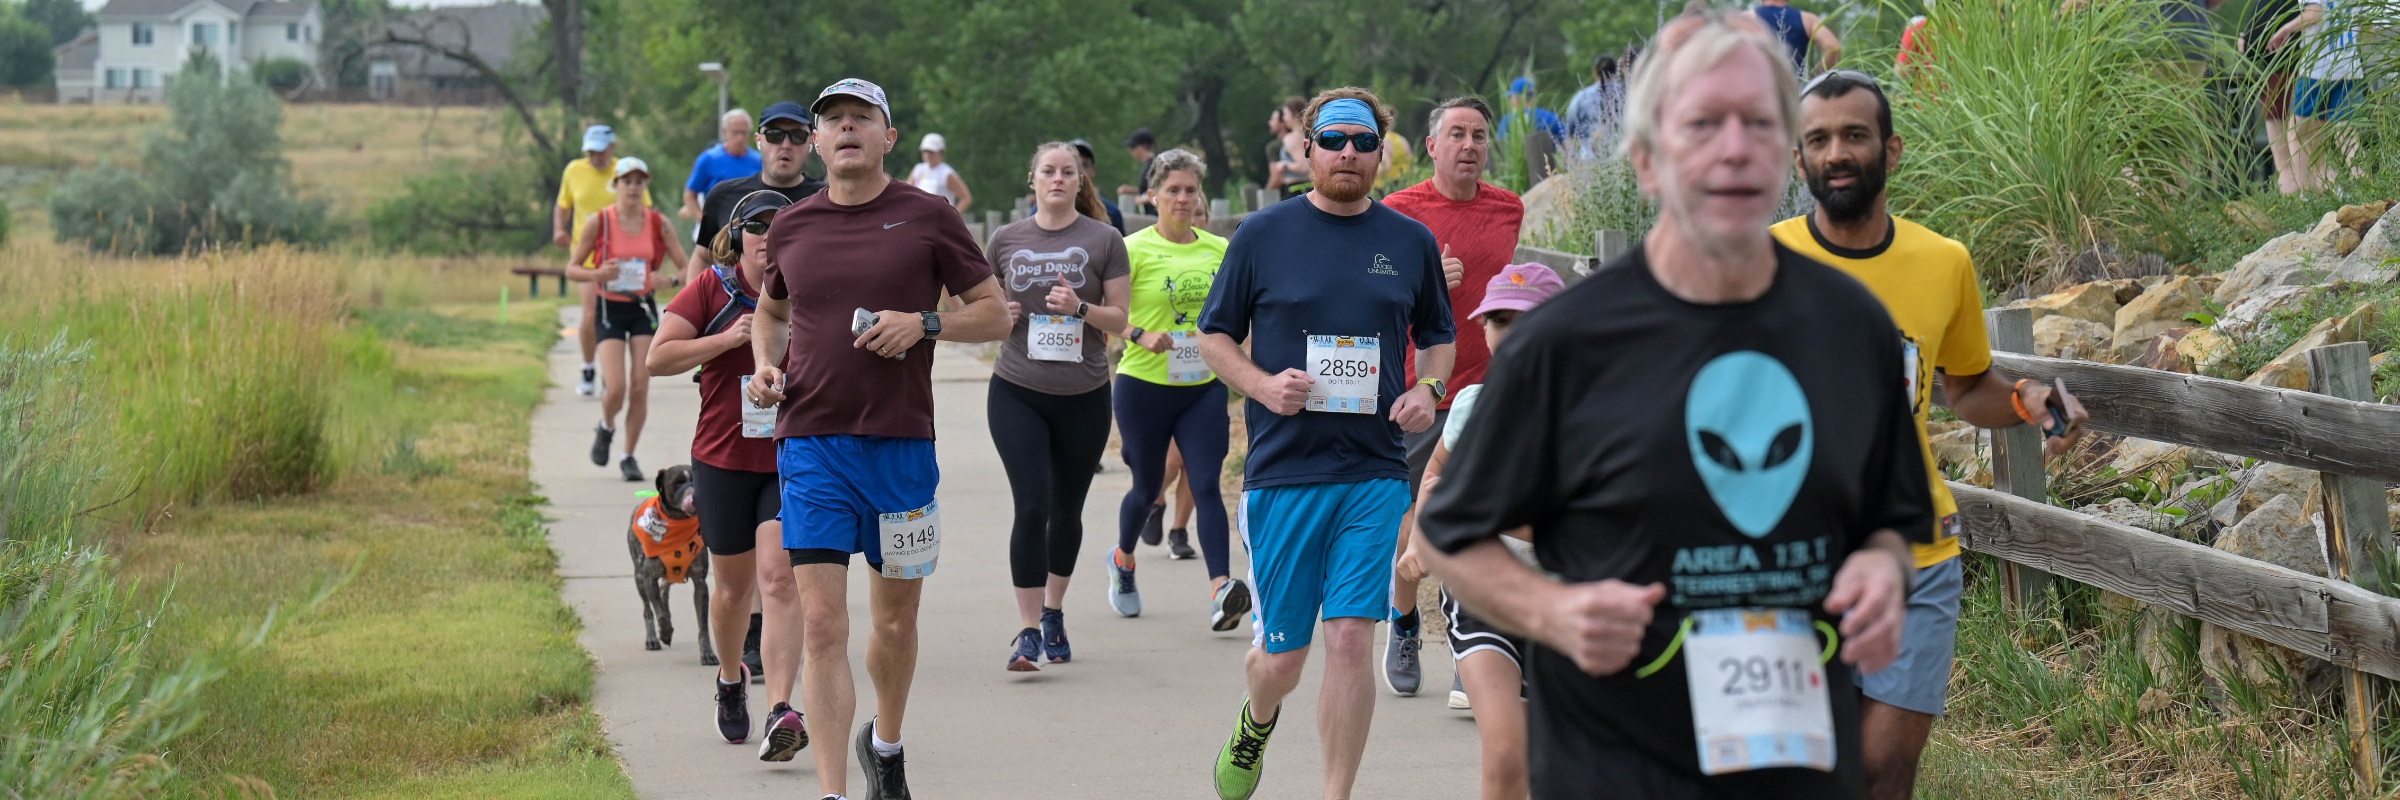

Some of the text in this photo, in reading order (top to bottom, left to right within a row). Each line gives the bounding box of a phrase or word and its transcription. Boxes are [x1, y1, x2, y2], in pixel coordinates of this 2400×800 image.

[1017, 262, 1078, 276] Dog Days
[1037, 332, 1074, 346] 2855
[1176, 346, 1200, 358] 289
[1320, 359, 1368, 378] 2859
[893, 525, 934, 548] 3149
[1671, 544, 1761, 572] AREA
[1718, 654, 1804, 695] 2911
